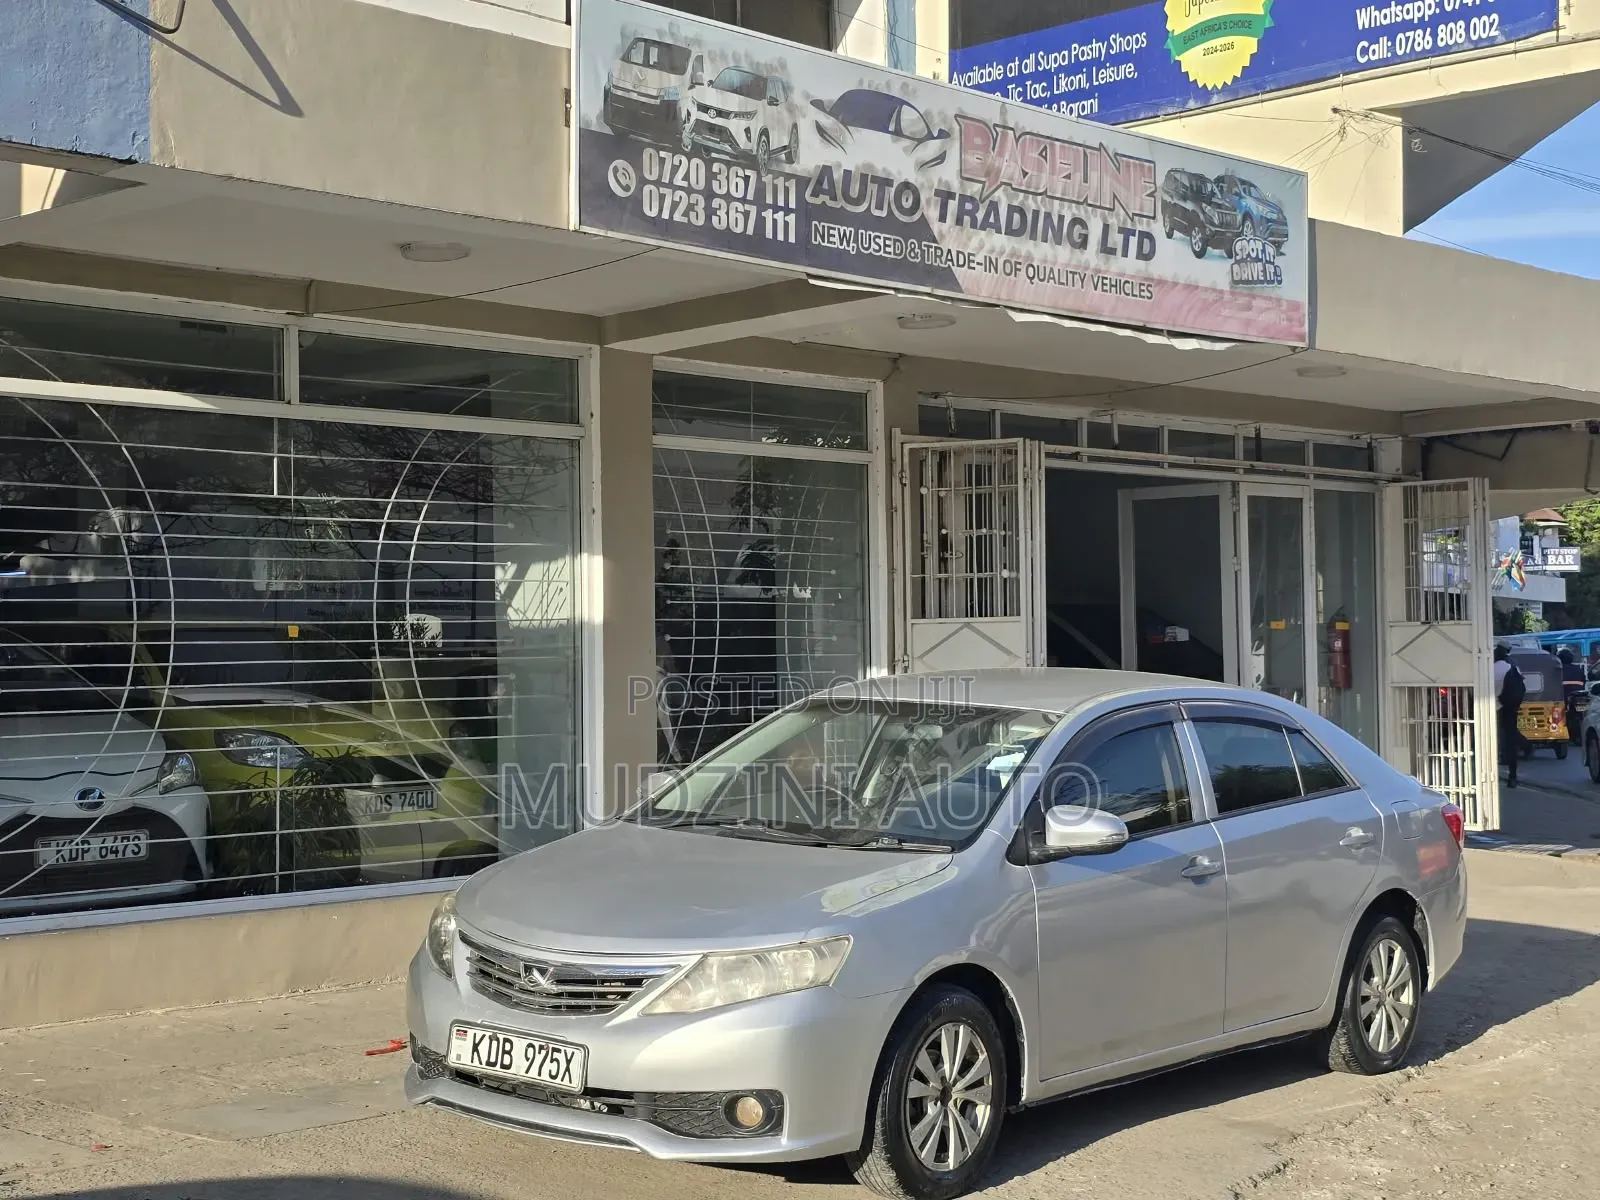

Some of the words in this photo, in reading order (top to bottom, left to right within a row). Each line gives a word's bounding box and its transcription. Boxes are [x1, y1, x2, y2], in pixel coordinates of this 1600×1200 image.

[1183, 30, 1198, 45] EAST
[1199, 20, 1228, 35] AFRICA'S
[1229, 19, 1252, 30] CHOICE
[1356, 0, 1440, 30] Whatsapp:
[1202, 41, 1235, 57] 2024-2026
[1356, 36, 1392, 63] Call:
[1395, 27, 1433, 56] 0786
[1437, 20, 1466, 47] 808
[1469, 13, 1499, 40] 002
[951, 64, 1004, 88] Available
[1007, 57, 1019, 78] at
[1022, 53, 1035, 73] all
[1038, 48, 1069, 73] Supa
[1071, 40, 1106, 63] Pastry
[1110, 30, 1148, 56] Shops
[1007, 84, 1023, 102] Tic
[1025, 81, 1050, 101] Tac,
[1053, 68, 1090, 95] Likoni,
[1092, 62, 1138, 86] Leisure,
[1060, 92, 1099, 117] Barani
[642, 147, 706, 190] 0720
[711, 160, 758, 202] 367
[761, 174, 797, 210] 111
[954, 113, 1157, 222] BASELINE
[642, 185, 706, 227] 0723
[711, 198, 758, 238] 367
[761, 211, 796, 244] 111
[807, 163, 922, 222] AUTO
[934, 188, 1088, 251] TRADING
[1099, 225, 1157, 263] LTD
[811, 220, 856, 253] NEW,
[858, 231, 905, 260] USED
[906, 240, 921, 263] &
[921, 241, 999, 278] TRADE-IN
[1002, 257, 1022, 279] OF
[1025, 265, 1087, 291] QUALITY
[1090, 274, 1154, 301] VEHICLES
[1235, 239, 1263, 260] SPOT
[1265, 243, 1275, 263] IT
[1232, 262, 1265, 281] DRIVE
[1547, 554, 1574, 565] BAR
[55, 841, 91, 864] KDP
[98, 835, 142, 860] 647S
[470, 1032, 514, 1071] KDB
[524, 1041, 575, 1085] 975X
